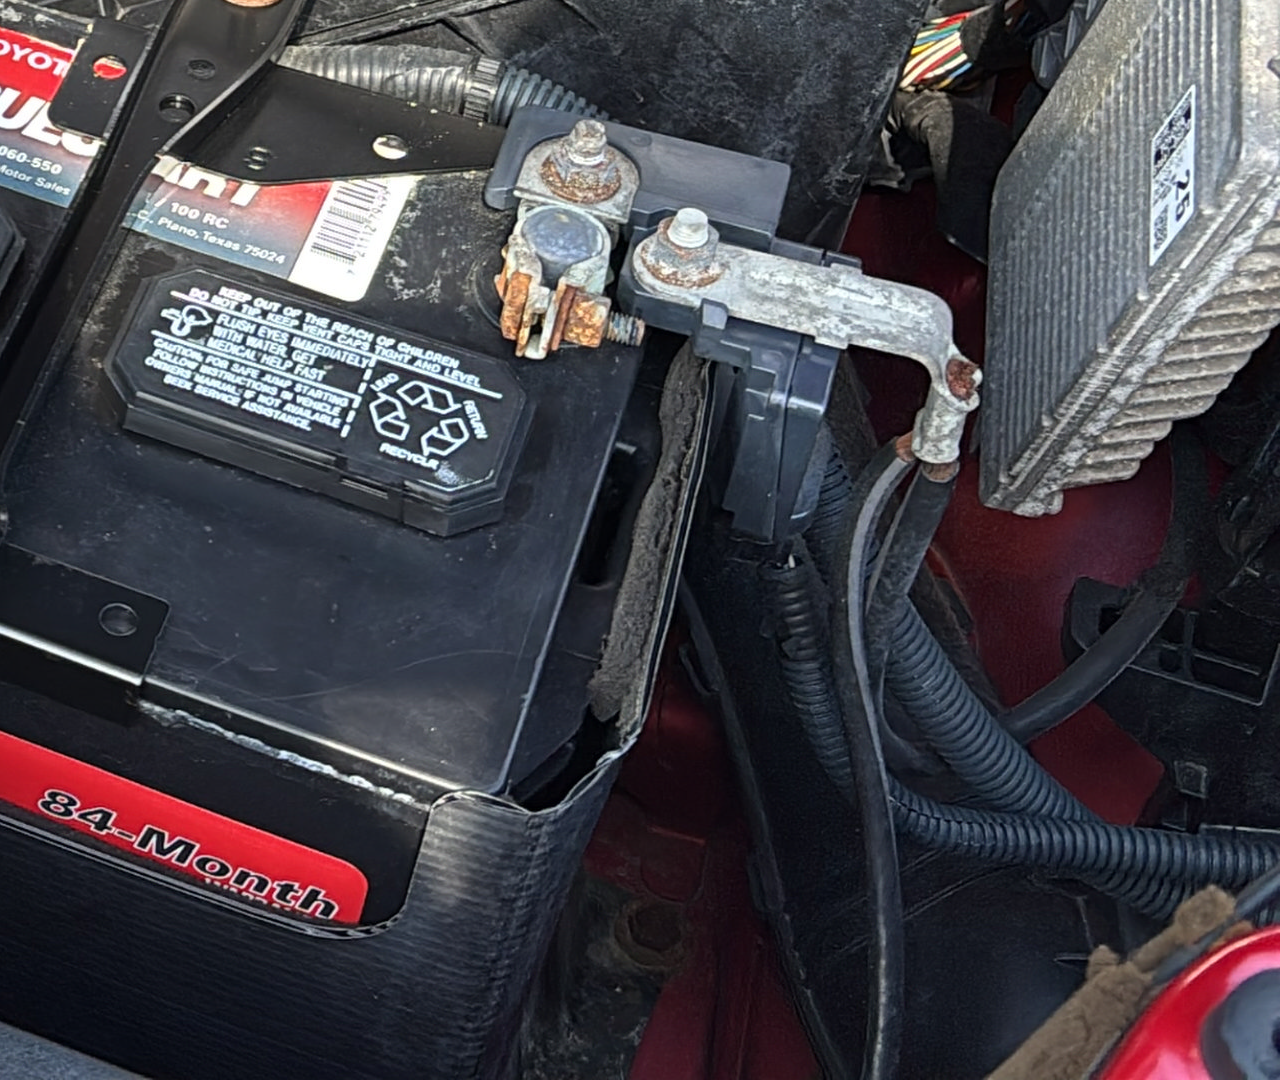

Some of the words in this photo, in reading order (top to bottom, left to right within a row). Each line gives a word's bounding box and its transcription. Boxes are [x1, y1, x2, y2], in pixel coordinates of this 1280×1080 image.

[34, 175, 71, 196] Sales
[170, 202, 200, 220] 100
[202, 212, 229, 229] RC
[158, 216, 199, 239] Plano,
[202, 230, 242, 252] Texas
[244, 243, 286, 264] 75024
[187, 287, 210, 301] DO
[209, 295, 238, 310] NOT
[265, 312, 300, 330] KEEP
[299, 323, 335, 340] VENT
[335, 333, 370, 351] CAPS
[373, 345, 413, 365] TIGHT
[412, 357, 441, 373] AND
[442, 367, 483, 387] LEVEL
[210, 325, 244, 343] WITH
[289, 349, 318, 366] GET
[215, 313, 257, 333] FLUSH
[256, 325, 290, 344] EYES
[289, 336, 372, 369] IMMEDIATELY
[217, 286, 251, 303] KEEP
[251, 297, 281, 312] OUT
[280, 306, 302, 319] OF
[302, 313, 330, 328] THE
[329, 321, 375, 342] REACH
[374, 335, 396, 349] OF
[394, 341, 462, 369] CHILDREN
[151, 348, 199, 370] FOLLOW
[198, 363, 279, 396] INSTRUCTIONS
[293, 394, 342, 417] VEHICLE
[203, 354, 230, 370] FOR
[229, 362, 260, 379] SAFE
[259, 372, 293, 390] JUMP
[292, 383, 350, 408] STARTING
[205, 336, 260, 361] MEDICAL
[259, 353, 294, 372] HELP
[292, 363, 327, 383] FAST
[370, 372, 400, 392] LEAD
[162, 374, 193, 391] SEEK
[192, 384, 241, 407] SERVICE
[242, 388, 257, 401] IF
[255, 393, 282, 409] NOT
[281, 401, 342, 429] AVAILABLE
[462, 399, 488, 439] RETURN
[37, 788, 340, 920] 84-Month
